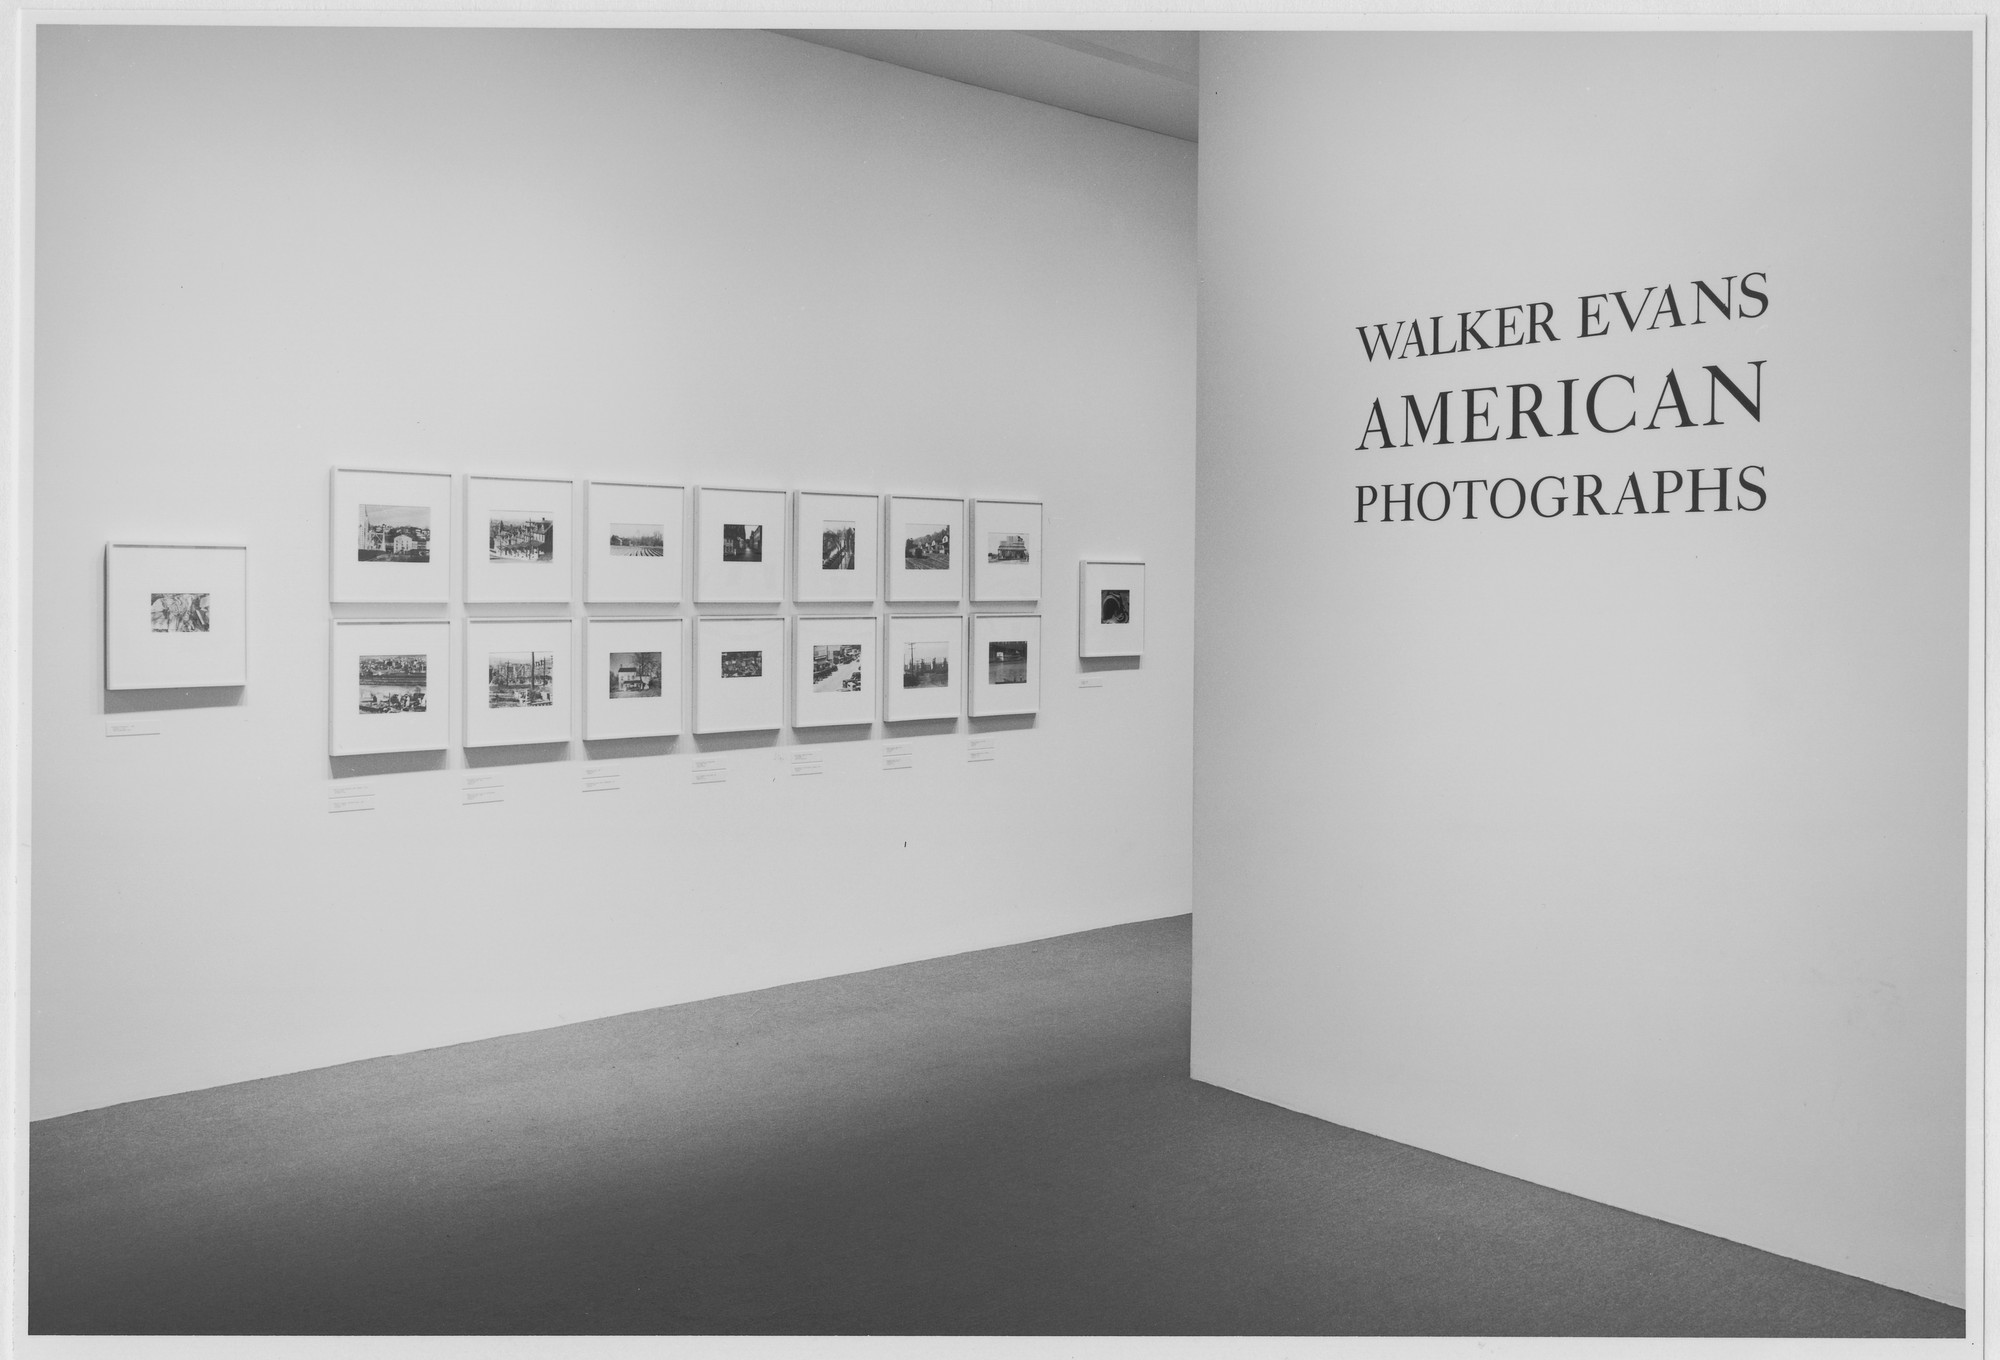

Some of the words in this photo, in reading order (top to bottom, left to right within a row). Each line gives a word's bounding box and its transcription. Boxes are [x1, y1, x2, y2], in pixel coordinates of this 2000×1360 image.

[1356, 302, 1560, 362] WALKER
[1577, 272, 1769, 339] EVANS
[1355, 360, 1767, 451] AMERICAN
[1354, 465, 1767, 523] PHOTOGRAPHS
